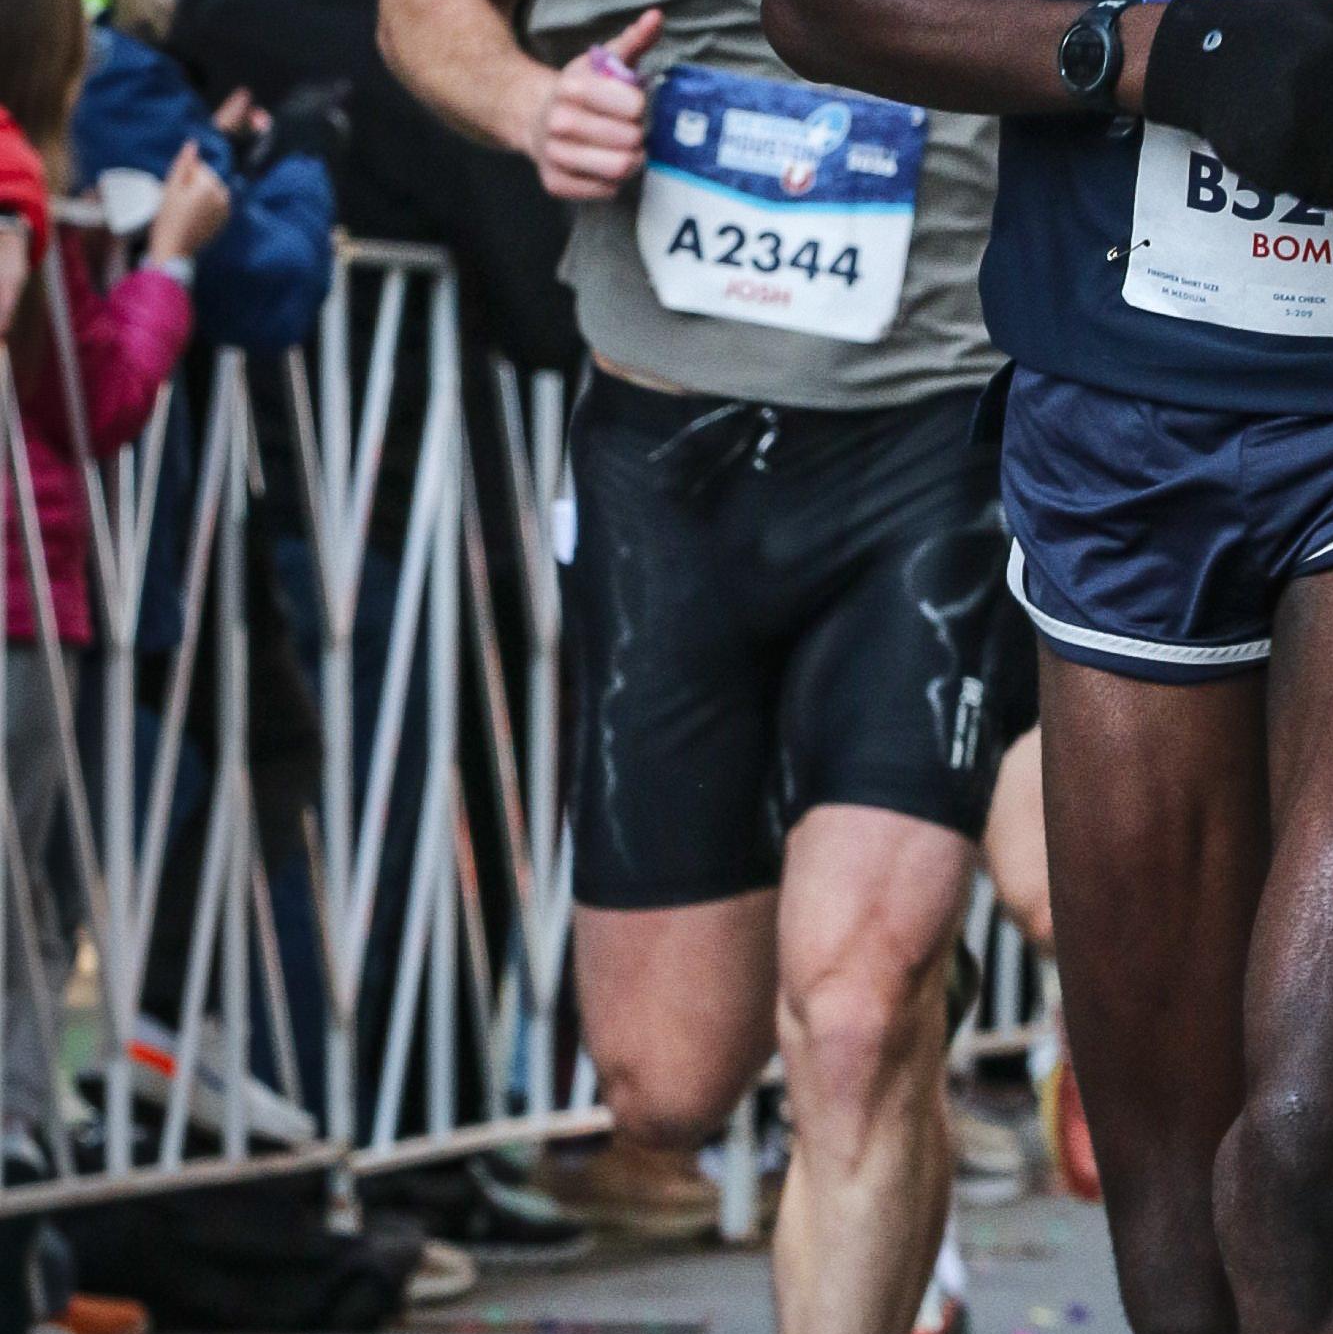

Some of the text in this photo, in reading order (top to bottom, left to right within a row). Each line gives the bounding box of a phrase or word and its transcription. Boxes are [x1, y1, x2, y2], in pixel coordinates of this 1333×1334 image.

[667, 218, 860, 287] A2344
[1273, 293, 1326, 304] GEAR CHECK
